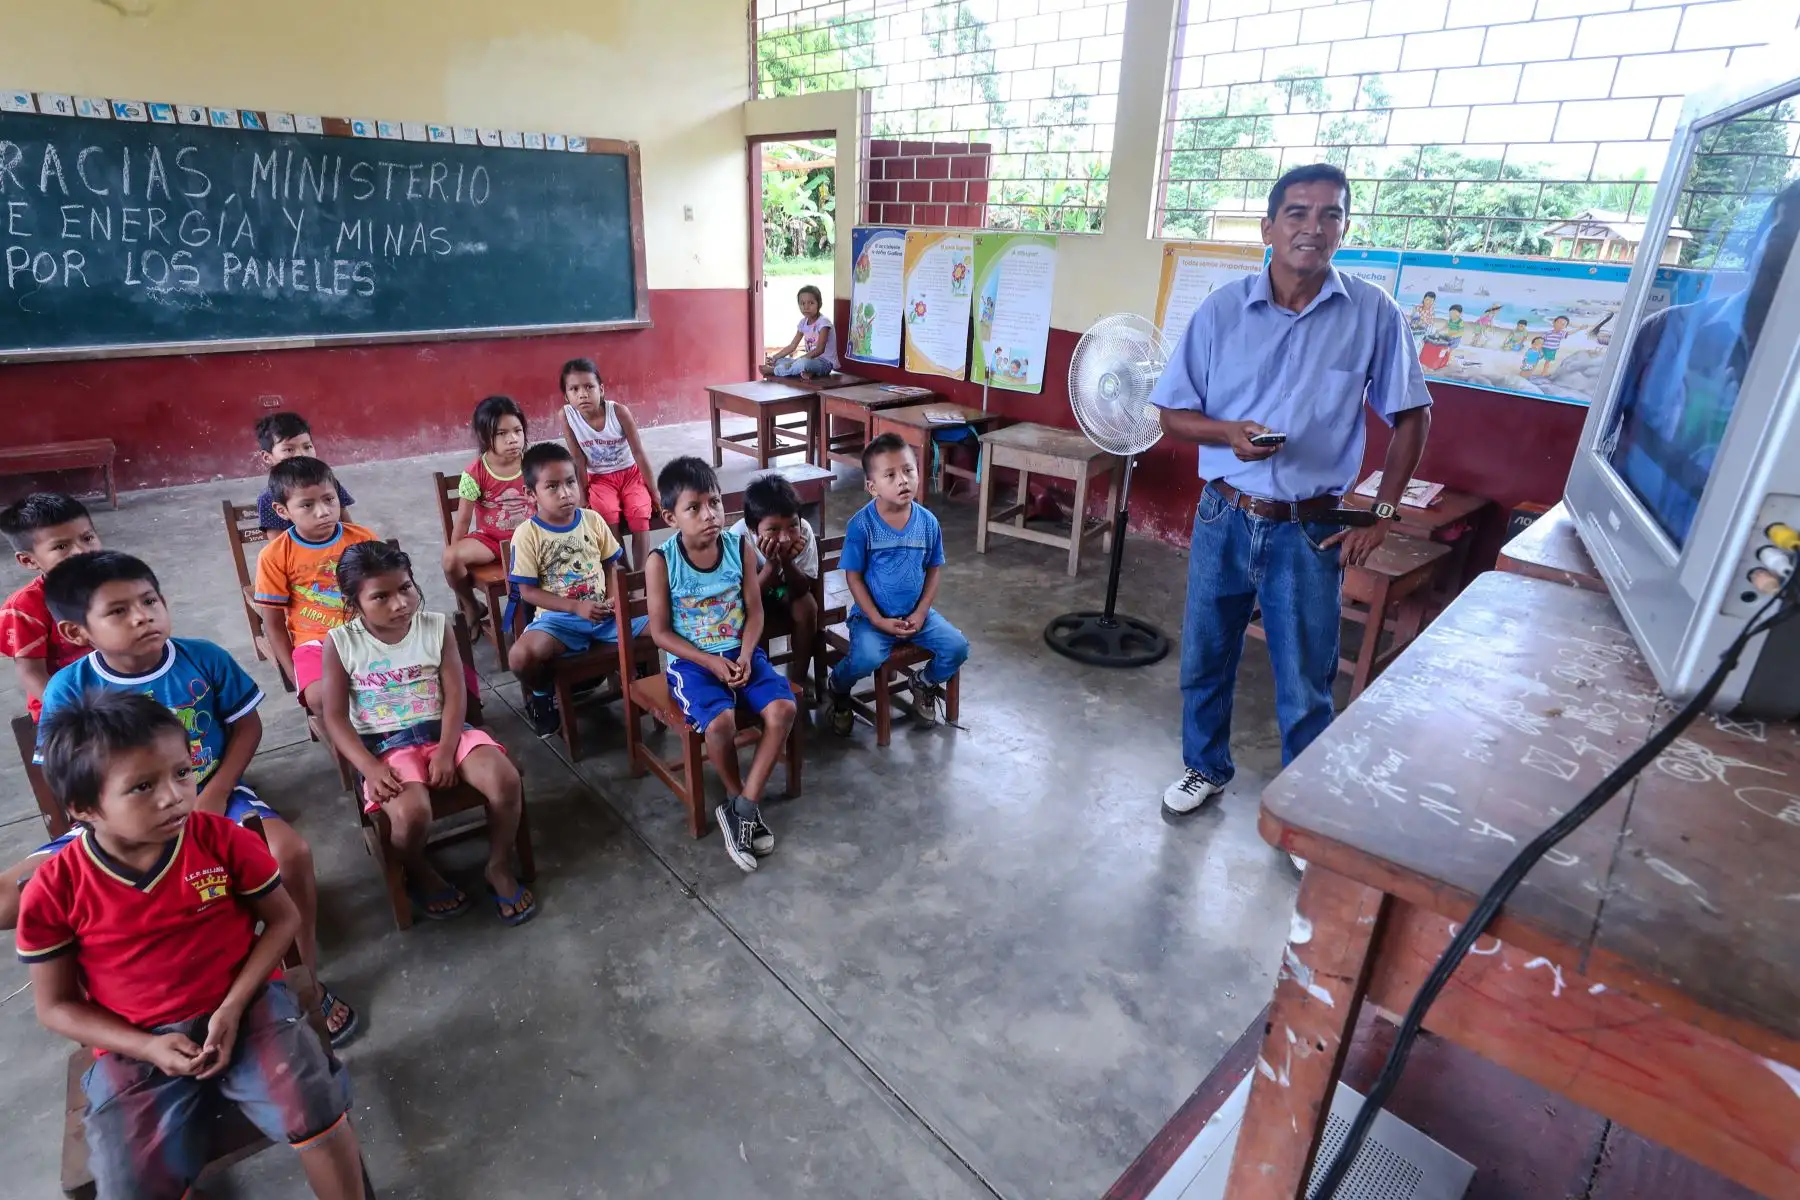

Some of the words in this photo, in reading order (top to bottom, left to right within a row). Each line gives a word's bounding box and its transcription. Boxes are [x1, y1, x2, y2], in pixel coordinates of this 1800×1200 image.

[251, 150, 491, 207] MINISTERIO
[282, 207, 304, 258] Y
[336, 219, 452, 258] MINAS
[6, 246, 91, 290] POR
[124, 249, 201, 286] LOS
[222, 251, 375, 296] PANELES
